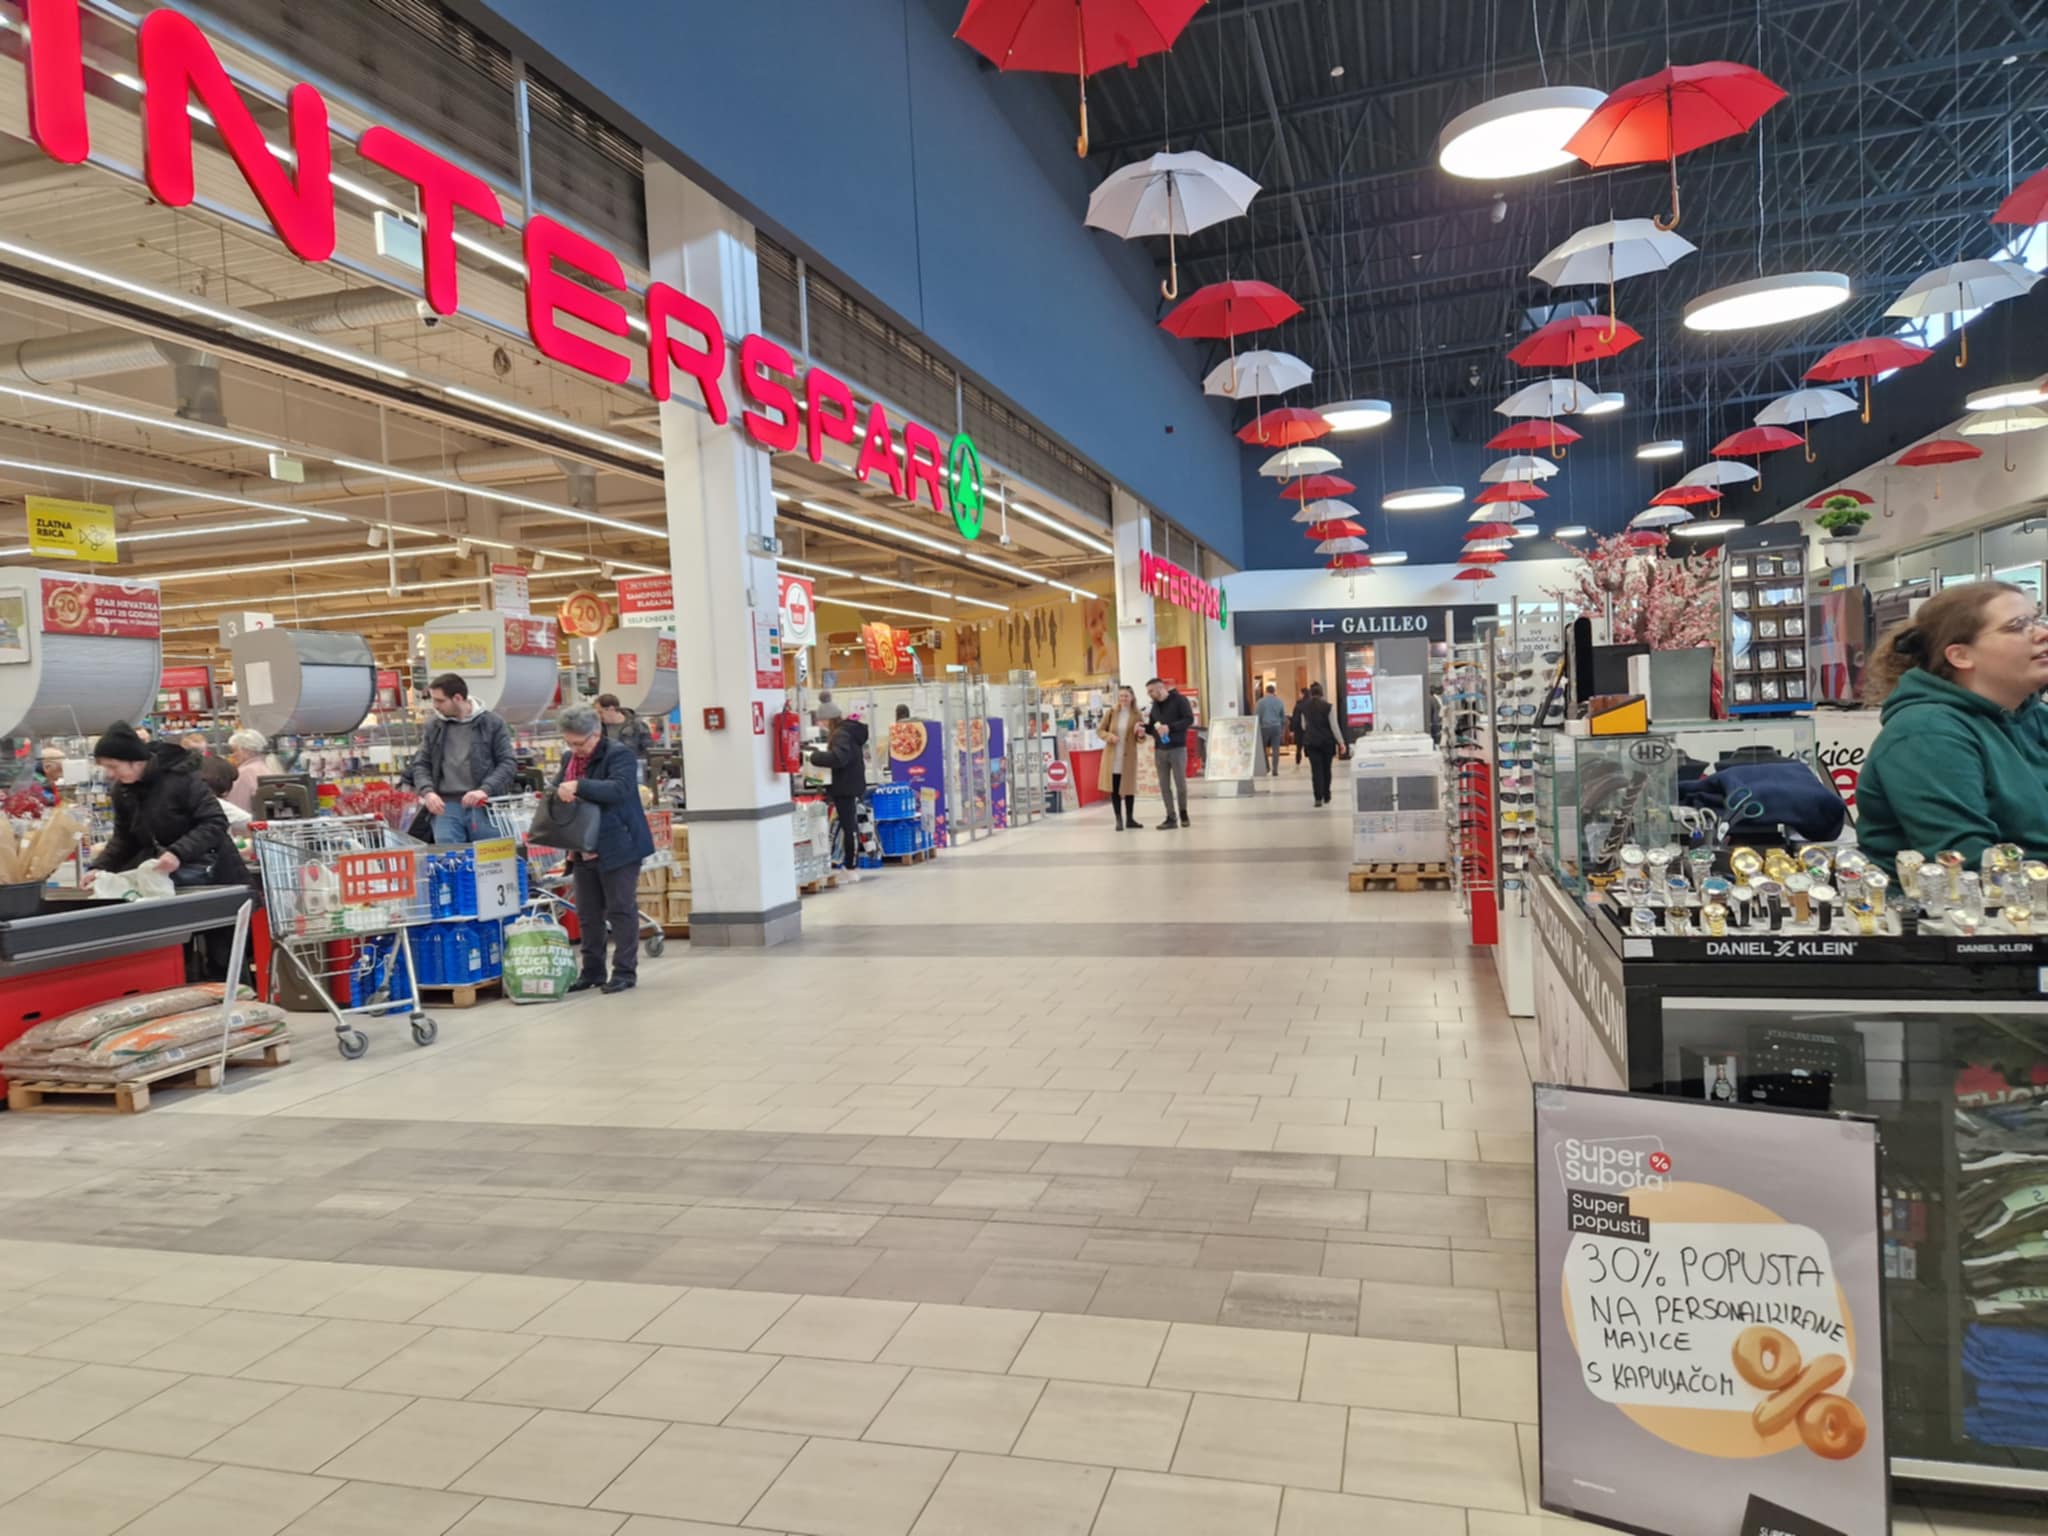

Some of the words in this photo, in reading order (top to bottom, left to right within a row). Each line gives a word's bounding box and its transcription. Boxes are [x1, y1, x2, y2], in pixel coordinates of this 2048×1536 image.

[25, 0, 943, 512] INTERSPAR
[1139, 549, 1220, 620] INTERSPAR
[227, 621, 239, 638] 3
[1341, 615, 1428, 633] GALILEO
[415, 632, 426, 649] 2
[1638, 744, 1665, 760] HR
[1706, 941, 1771, 956] DANIEL
[1798, 941, 1855, 956] KLEIN
[1957, 944, 1997, 953] DANIEL
[1998, 943, 2033, 953] KLEIN
[1576, 943, 1625, 1063] POKLONI
[1565, 1138, 1645, 1168] Super
[1565, 1160, 1664, 1192] Subota
[1572, 1193, 1625, 1214] Super
[1572, 1213, 1645, 1236] popusti.
[1582, 1243, 1666, 1288] 30%
[1680, 1246, 1824, 1287] POPUSTA
[1591, 1295, 1641, 1326] NA
[1604, 1327, 1692, 1353] MAJICE
[1587, 1361, 1602, 1383] S
[1612, 1362, 1734, 1396] KAPULJAČOM
